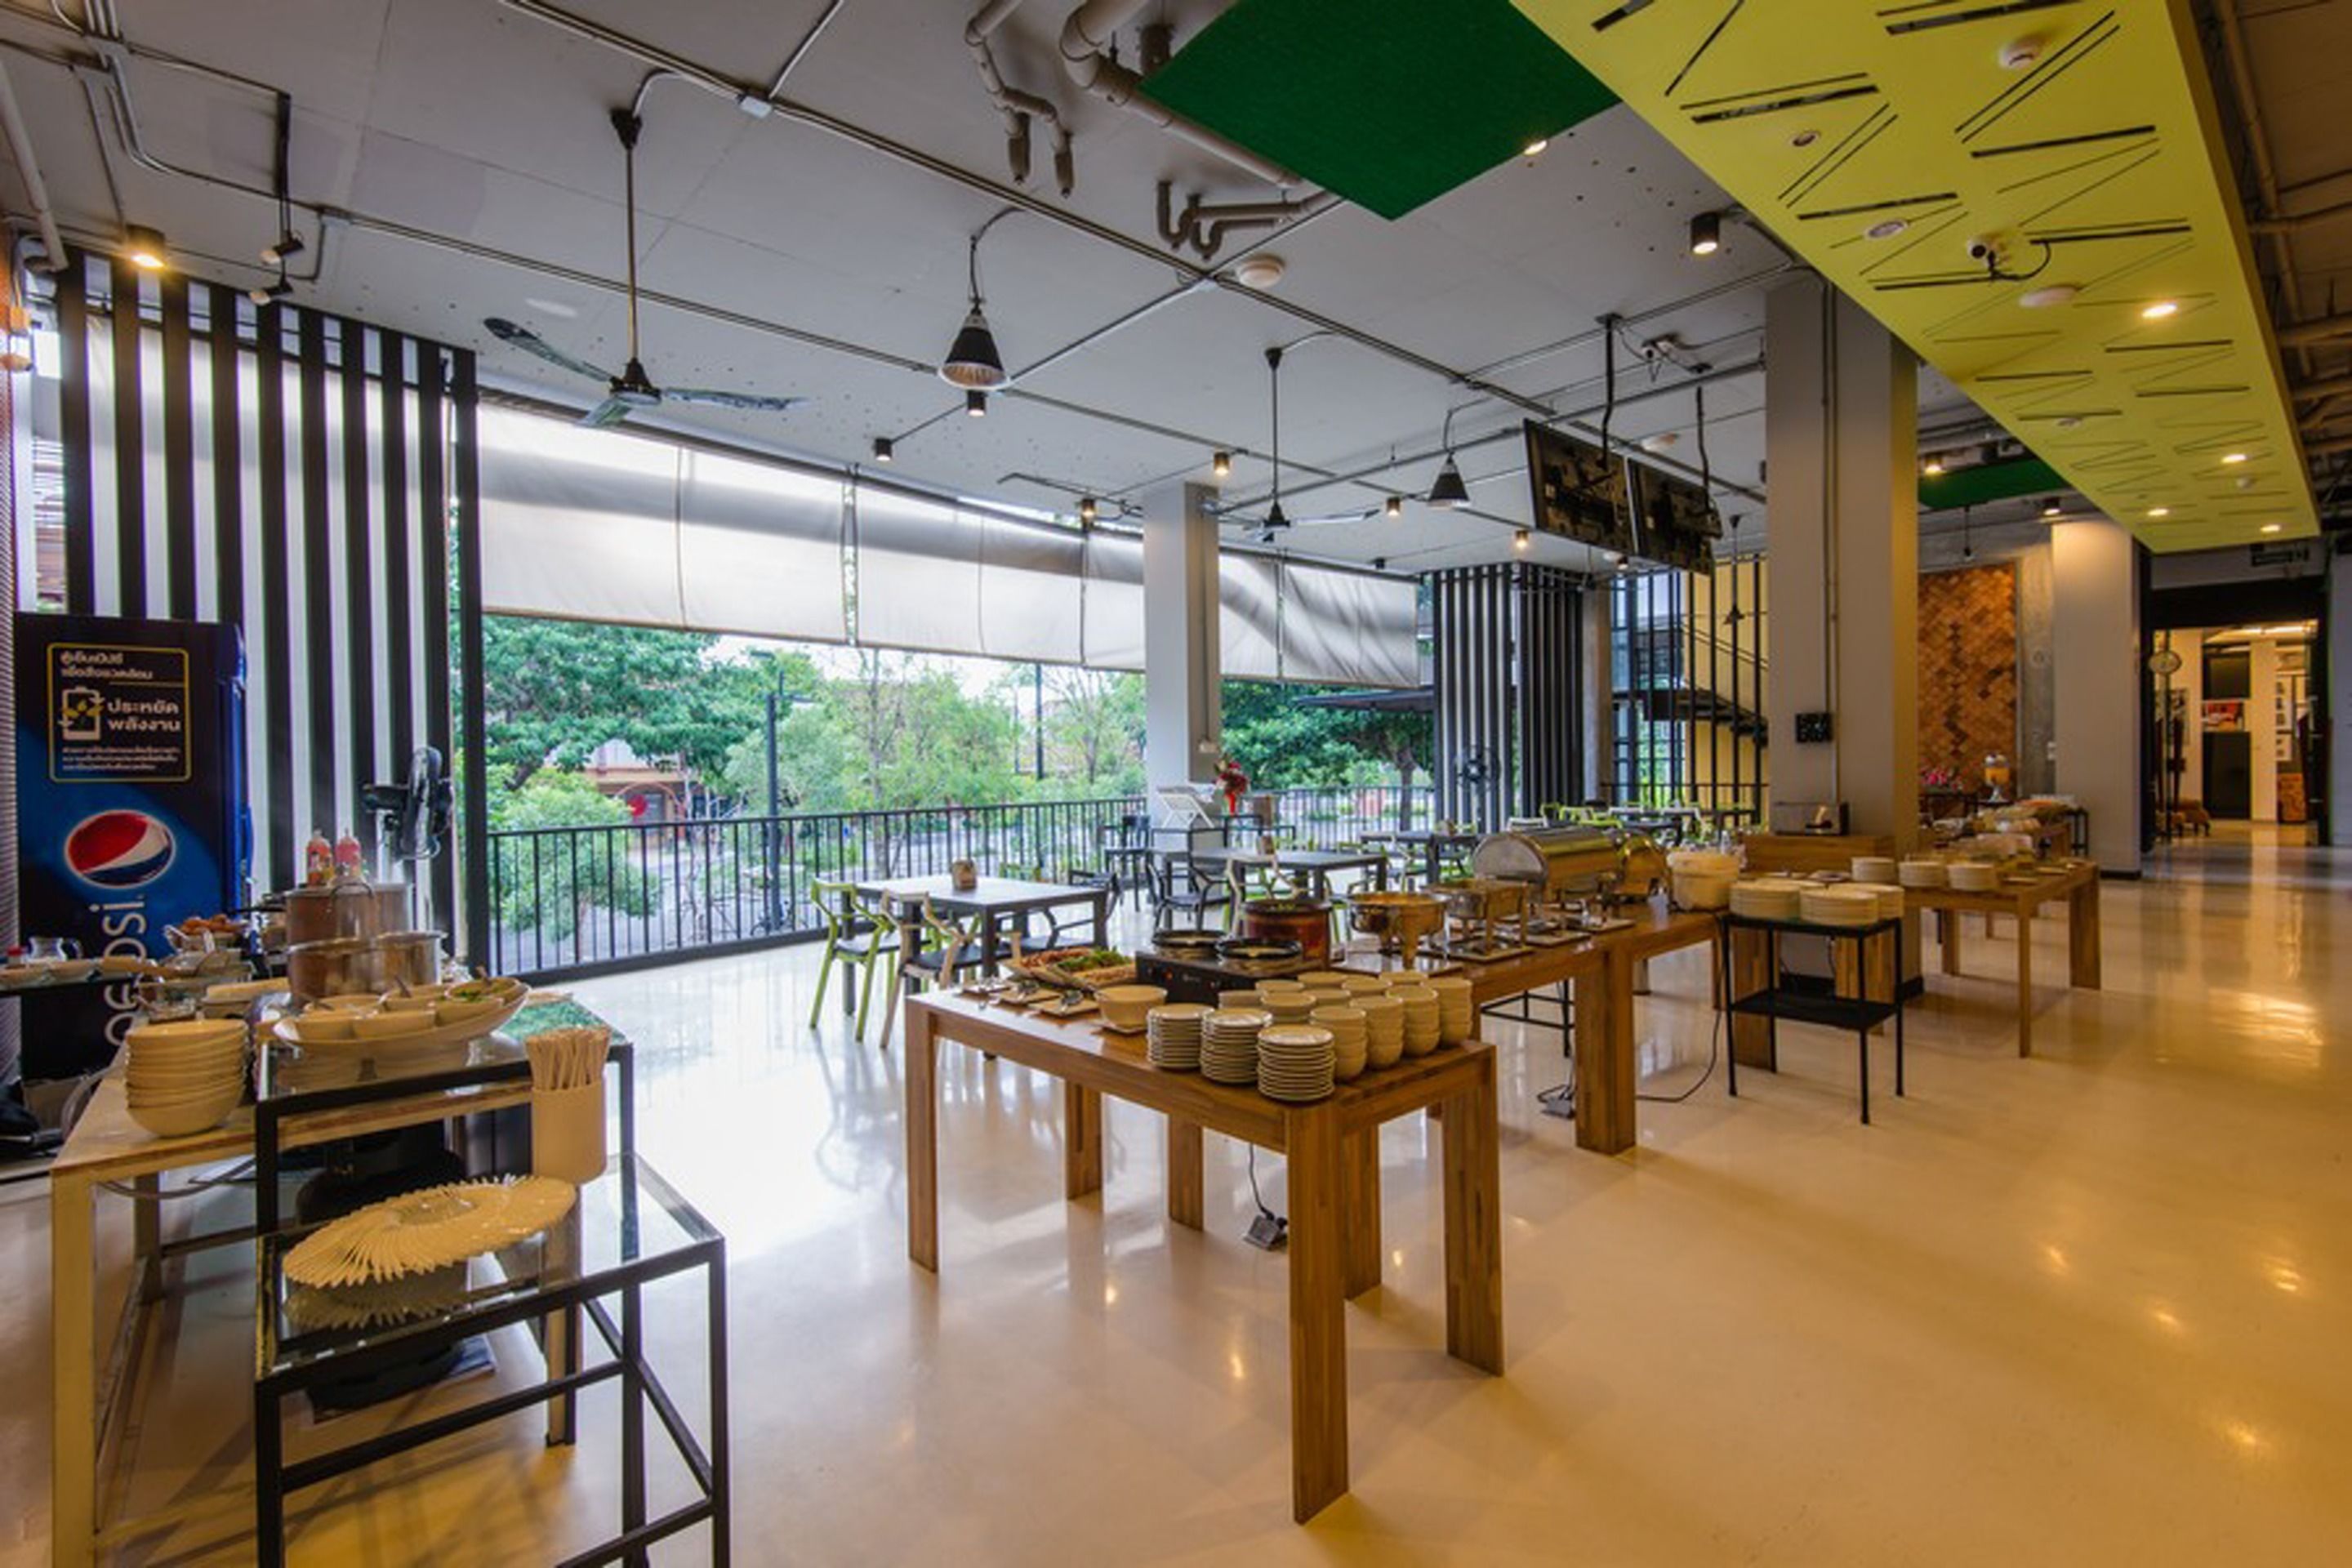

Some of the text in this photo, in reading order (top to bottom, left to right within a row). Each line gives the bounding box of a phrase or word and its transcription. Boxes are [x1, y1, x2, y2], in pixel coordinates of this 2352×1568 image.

[108, 698, 179, 715] ประหยัด
[108, 717, 182, 732] พลังงาน
